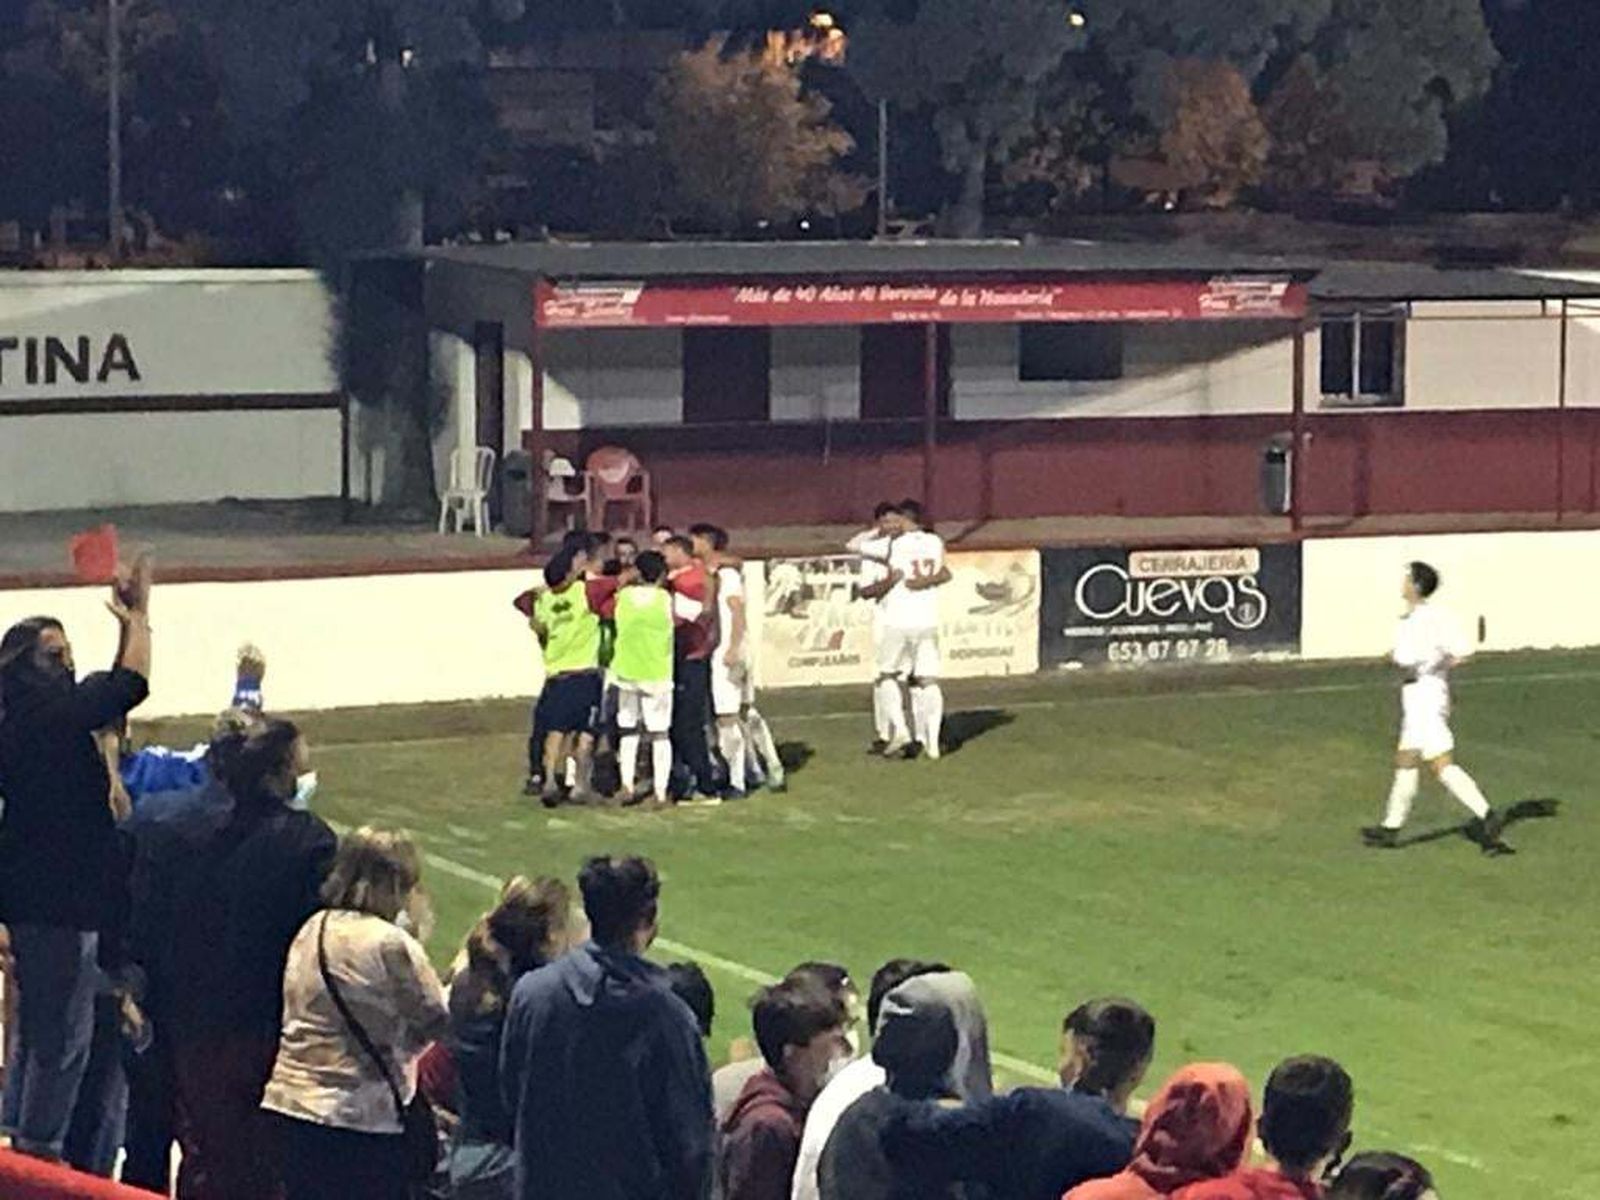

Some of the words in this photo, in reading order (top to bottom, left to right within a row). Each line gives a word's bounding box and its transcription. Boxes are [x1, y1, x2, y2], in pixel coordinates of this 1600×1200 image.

[910, 557, 935, 577] 17
[1075, 563, 1268, 629] Cuevas
[1108, 641, 1143, 661] 653
